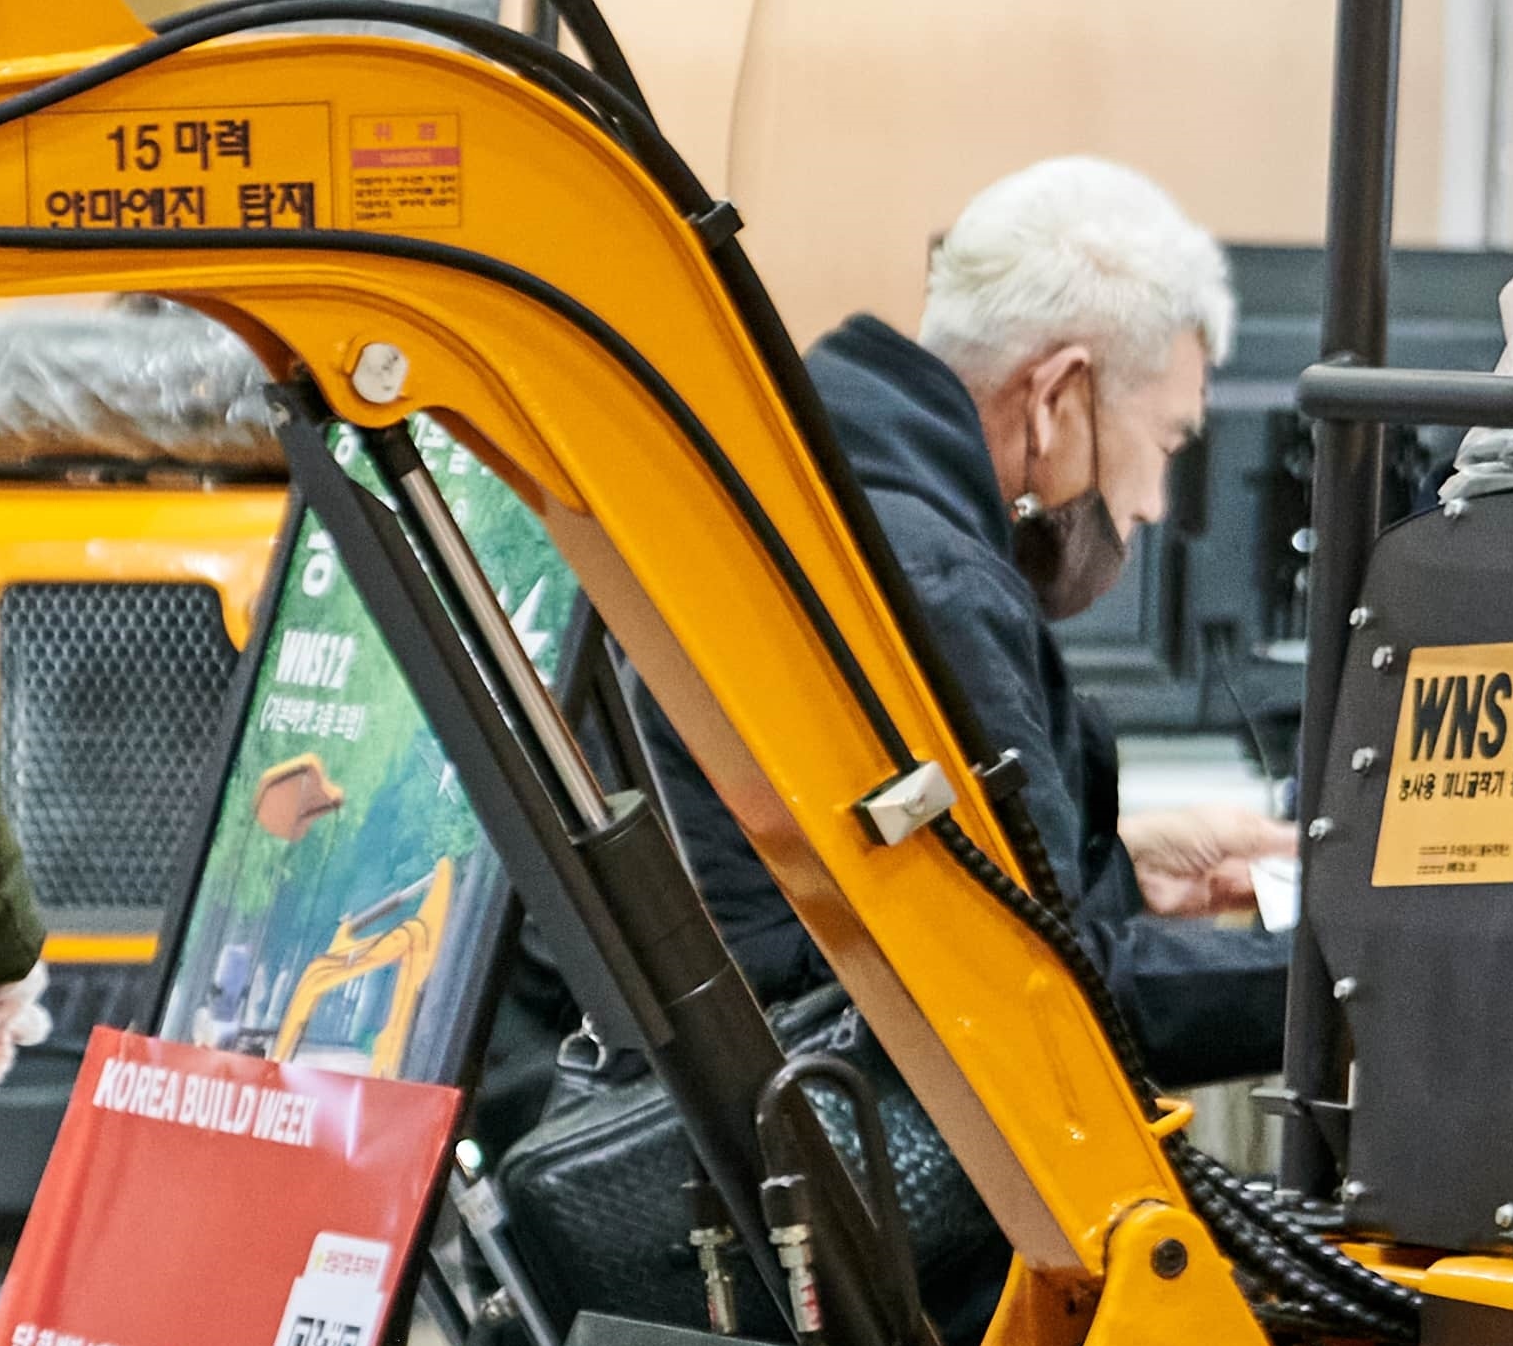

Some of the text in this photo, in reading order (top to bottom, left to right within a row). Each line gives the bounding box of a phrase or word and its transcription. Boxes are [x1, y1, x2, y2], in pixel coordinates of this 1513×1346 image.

[107, 119, 252, 171] 15 마력
[276, 629, 354, 689] WNS12
[1399, 772, 1435, 801] 농사용
[93, 1058, 319, 1147] KOREA BUILD WEEK
